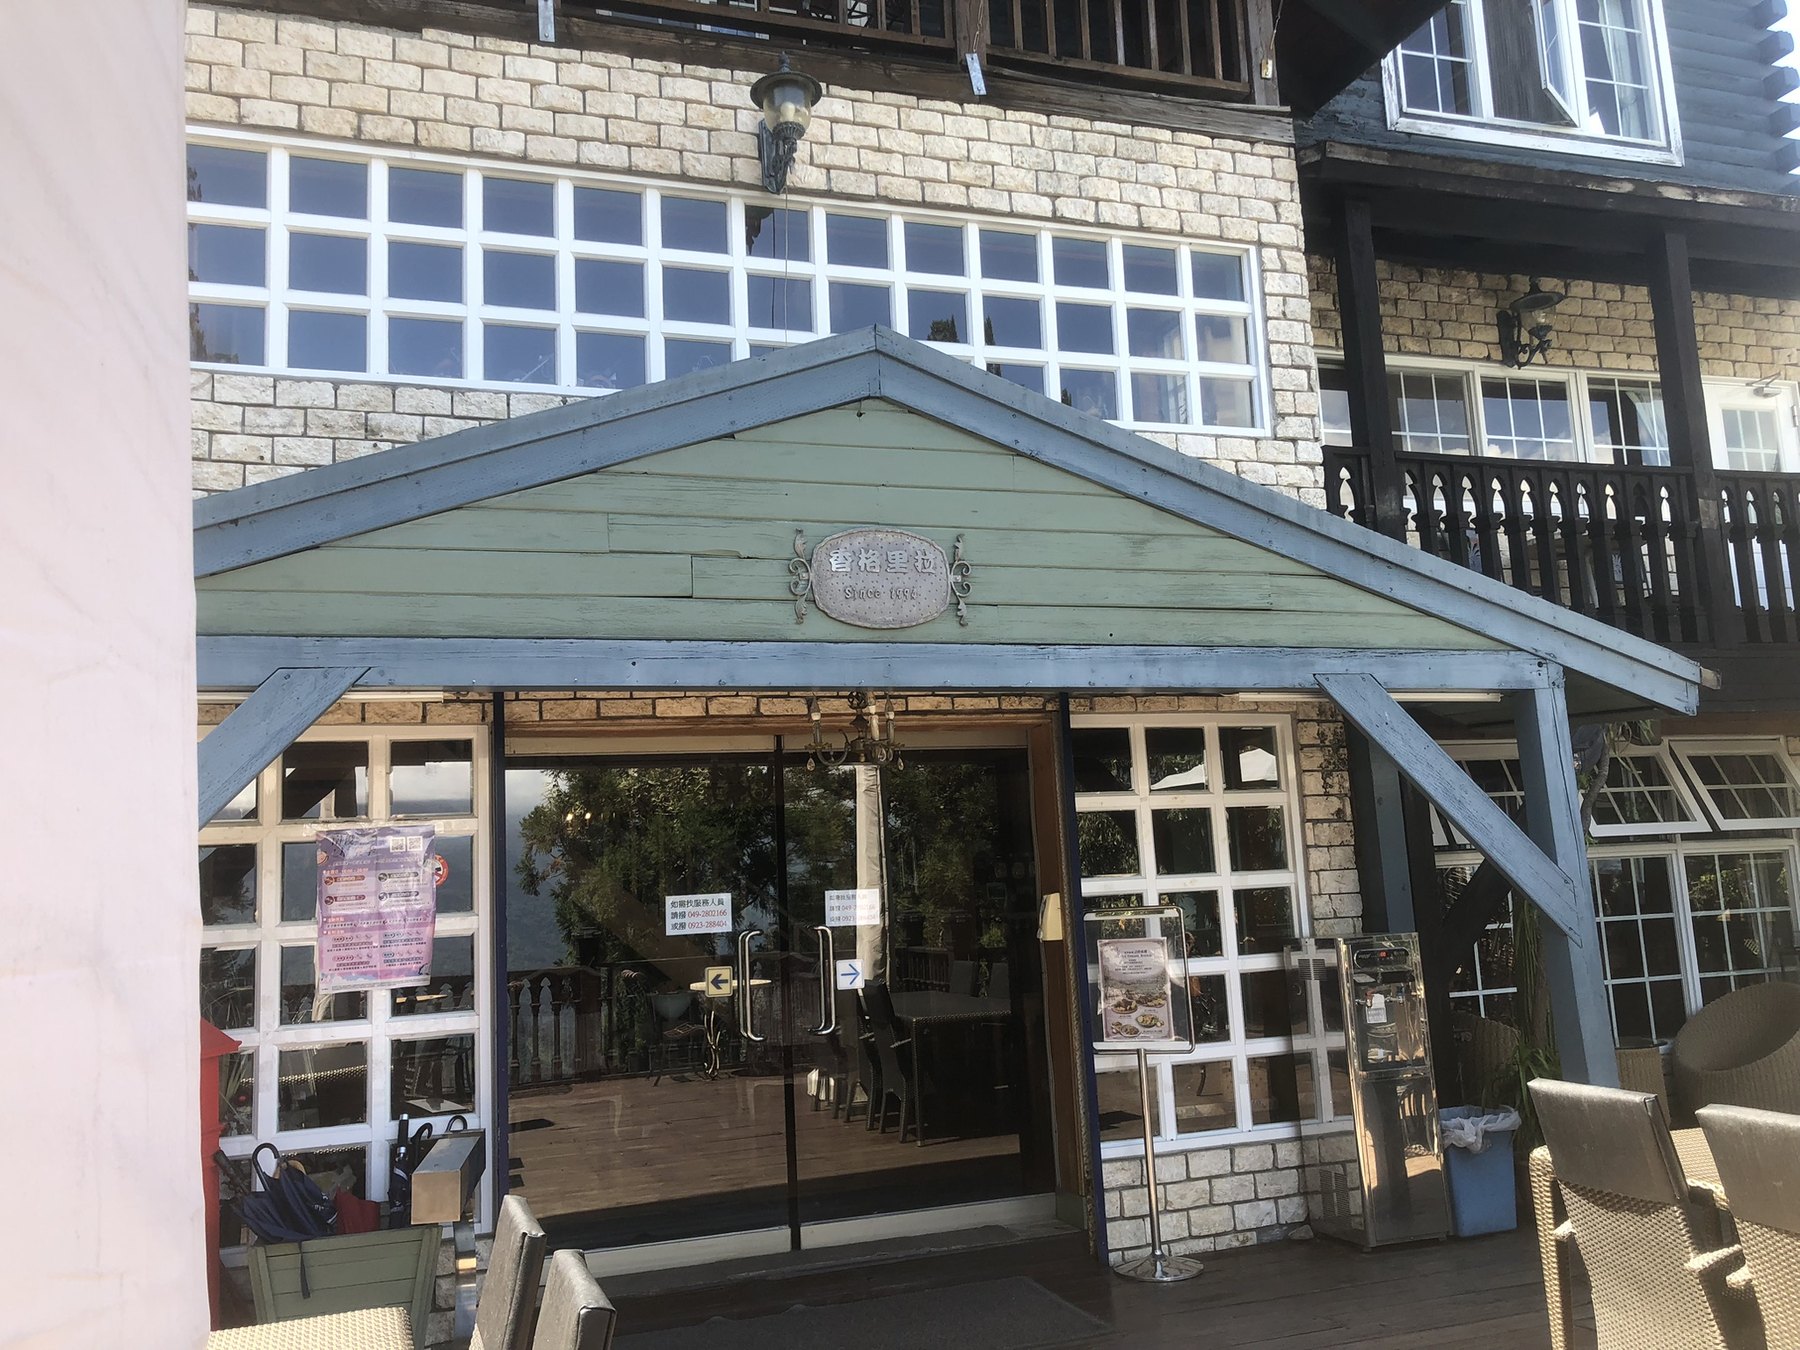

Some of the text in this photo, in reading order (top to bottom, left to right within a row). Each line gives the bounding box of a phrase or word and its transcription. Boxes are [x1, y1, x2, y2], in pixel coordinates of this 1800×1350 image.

[829, 548, 936, 574] 香格里拉
[844, 586, 880, 600] Since
[670, 898, 724, 909] 如需找服務人員
[687, 909, 728, 919] 049-2802166
